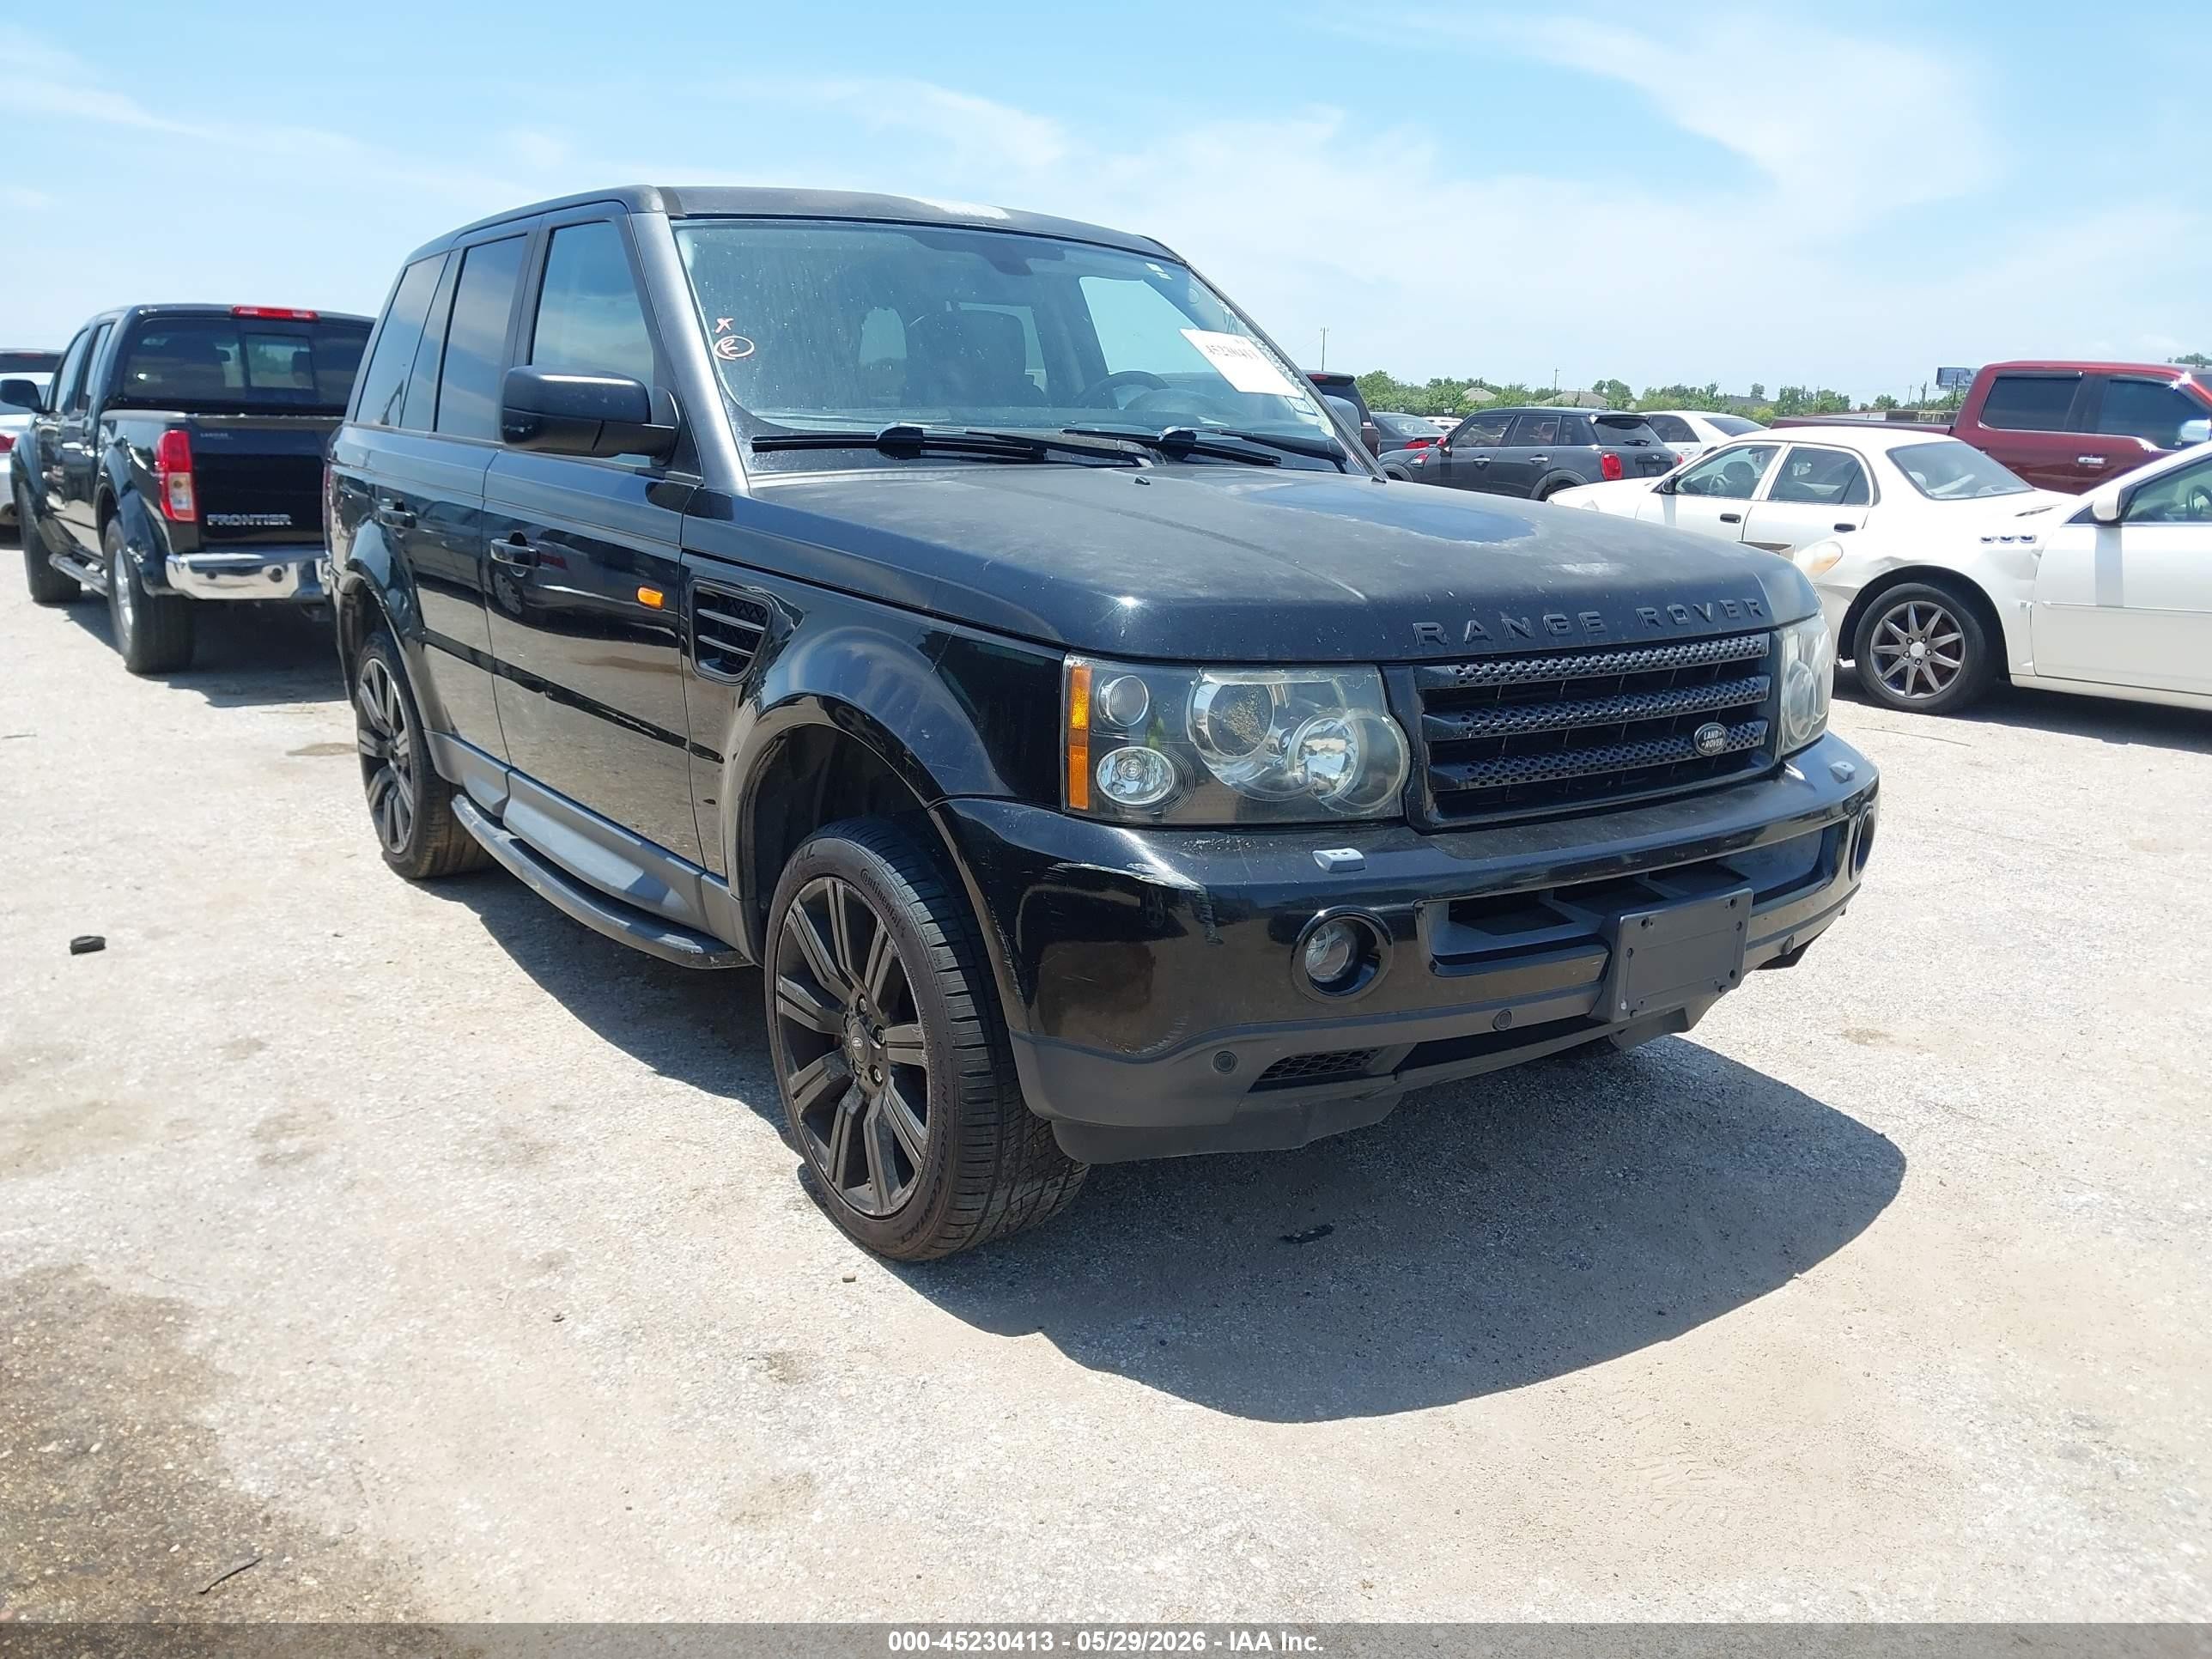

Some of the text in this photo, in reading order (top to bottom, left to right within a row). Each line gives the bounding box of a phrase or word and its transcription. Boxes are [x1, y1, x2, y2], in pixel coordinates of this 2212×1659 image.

[207, 514, 292, 526] FRONTIER
[1413, 598, 1765, 645] RANGE ROVER
[860, 868, 902, 927] Continental
